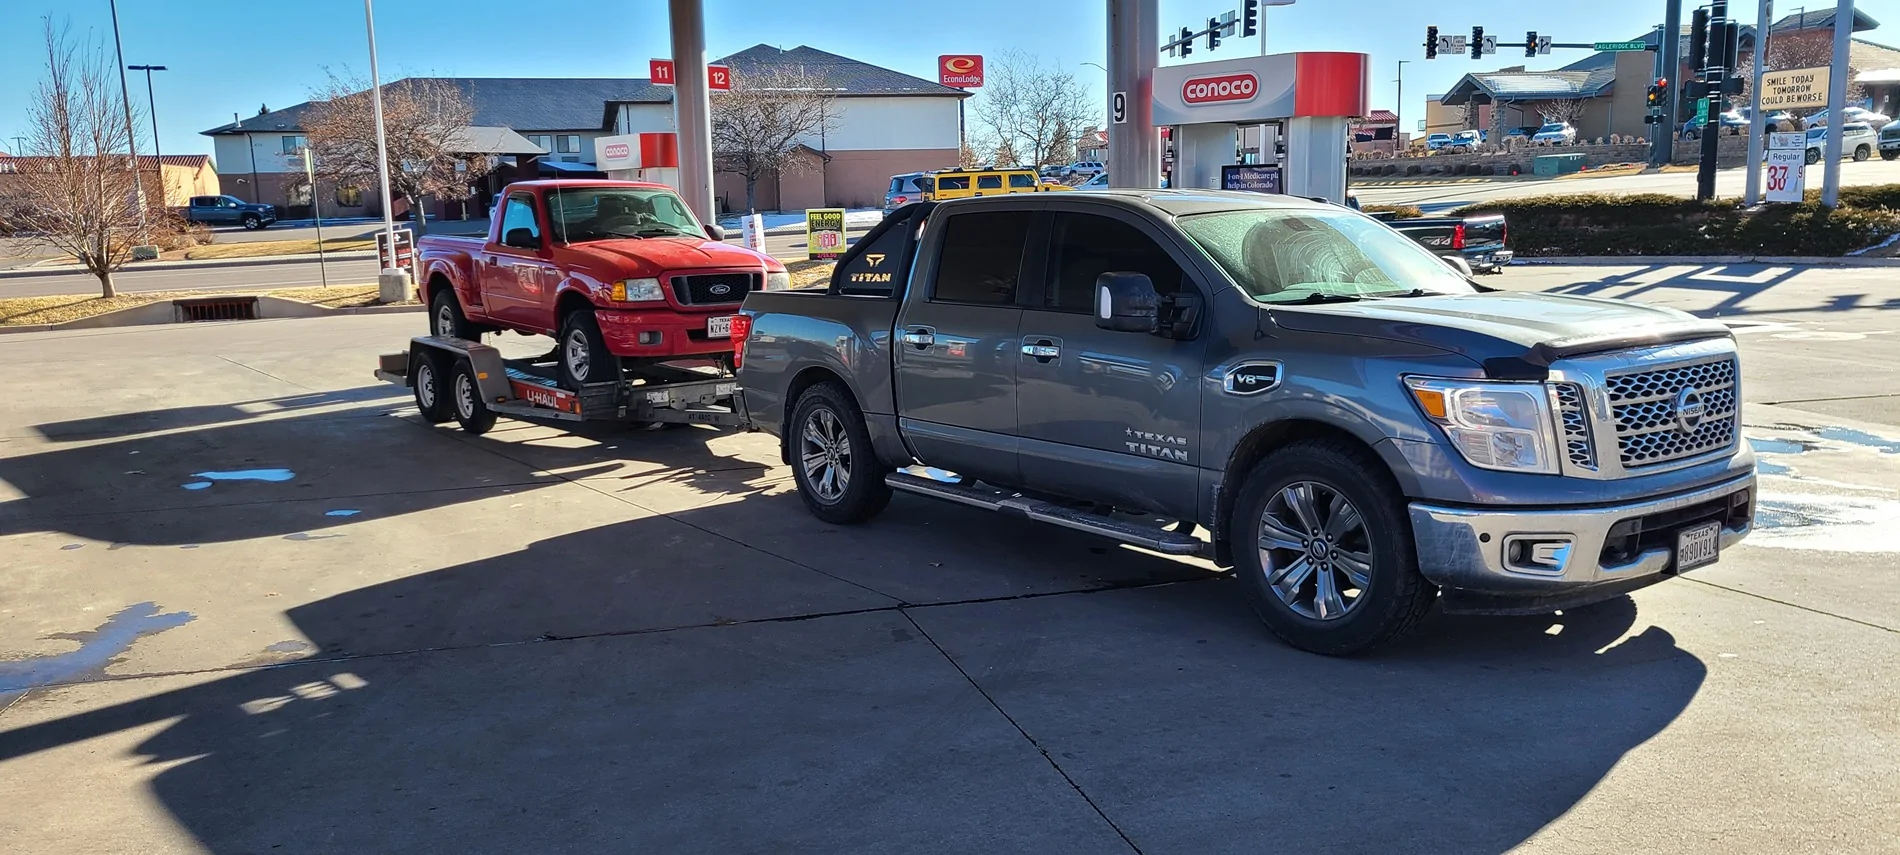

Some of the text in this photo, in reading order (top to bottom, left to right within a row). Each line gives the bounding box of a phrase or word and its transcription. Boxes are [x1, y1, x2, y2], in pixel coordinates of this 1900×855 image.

[656, 66, 669, 79] 11
[712, 72, 726, 84] 12
[943, 74, 981, 85] EconoLodge
[1766, 74, 1815, 87] SMILE TODAY
[1773, 84, 1812, 95] TOMORROW
[1761, 92, 1823, 105] COULD BE WORSE
[1113, 93, 1126, 122] 9
[1773, 152, 1800, 162] Regular
[1244, 172, 1270, 180] Medicare
[1247, 181, 1274, 189] Colorado
[811, 220, 840, 228] ENERGY
[850, 272, 892, 282] TITAN
[1236, 373, 1257, 385] V8
[1134, 430, 1187, 446] TEXAS
[1125, 441, 1188, 461] TITAN
[1690, 529, 1709, 541] TEXAS
